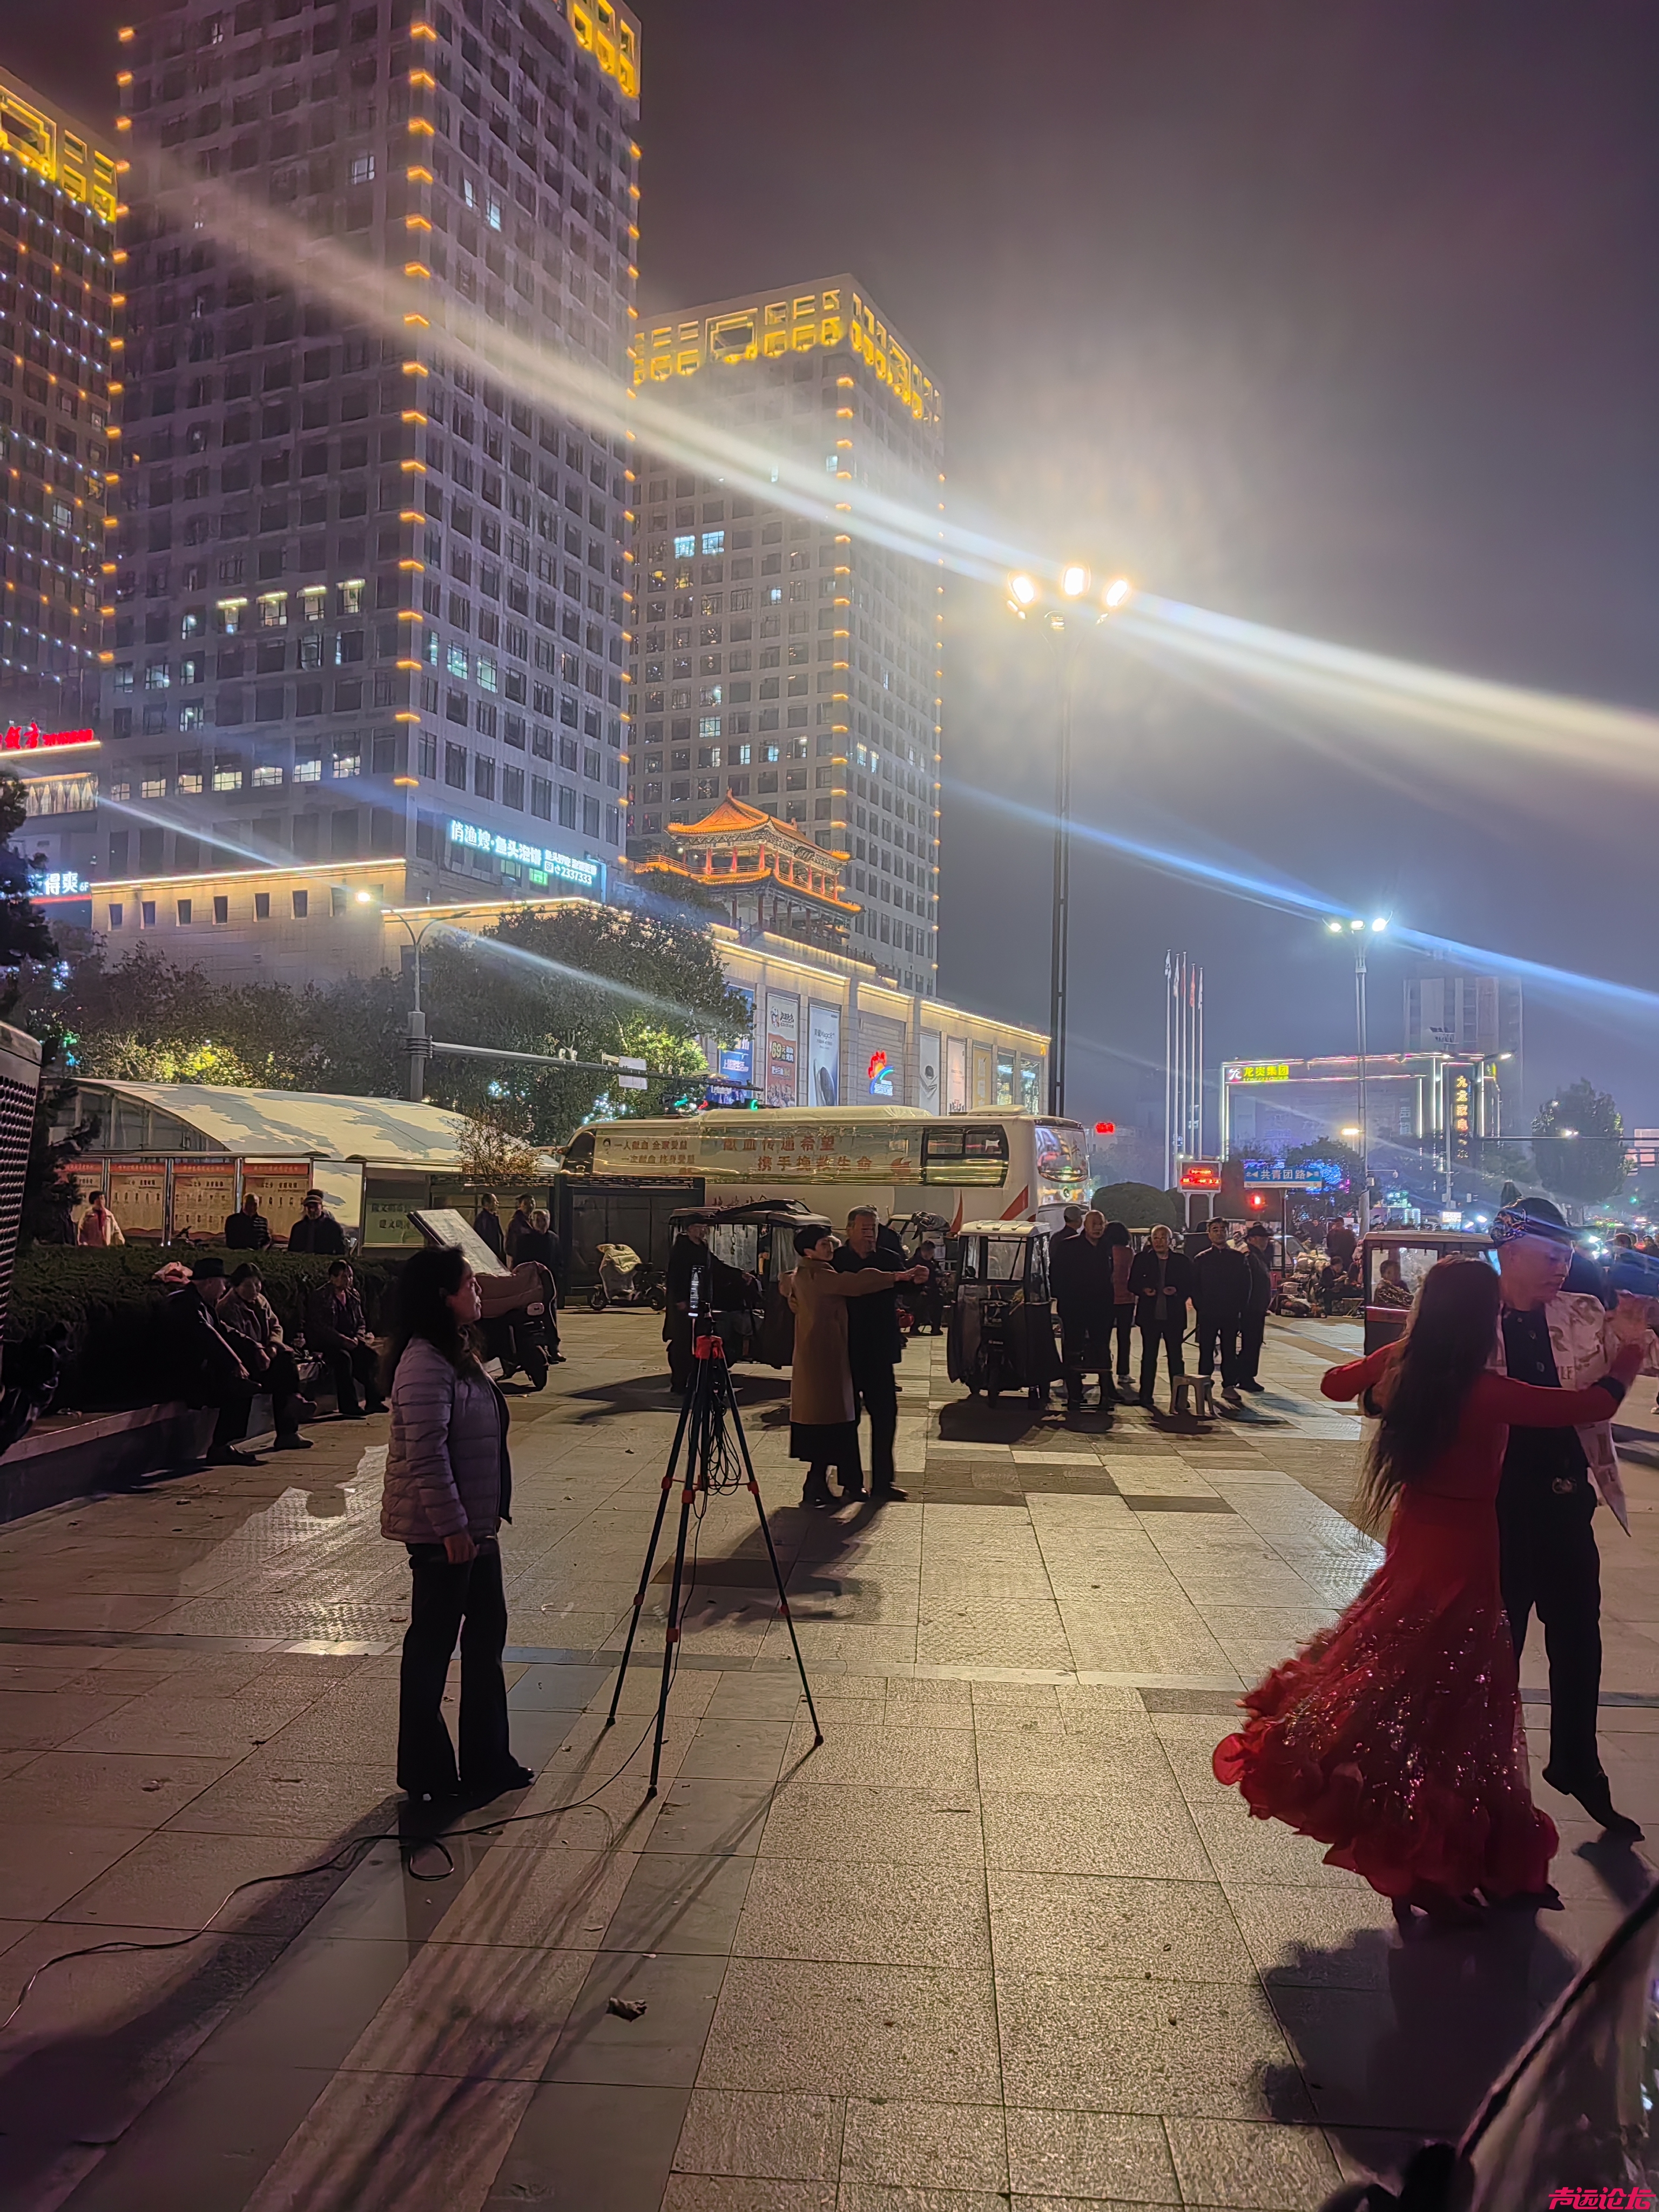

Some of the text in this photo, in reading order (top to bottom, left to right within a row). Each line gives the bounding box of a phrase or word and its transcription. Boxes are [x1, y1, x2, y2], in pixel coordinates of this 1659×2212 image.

[79, 882, 89, 892] 6F
[1260, 1169, 1306, 1180] 共青团路
